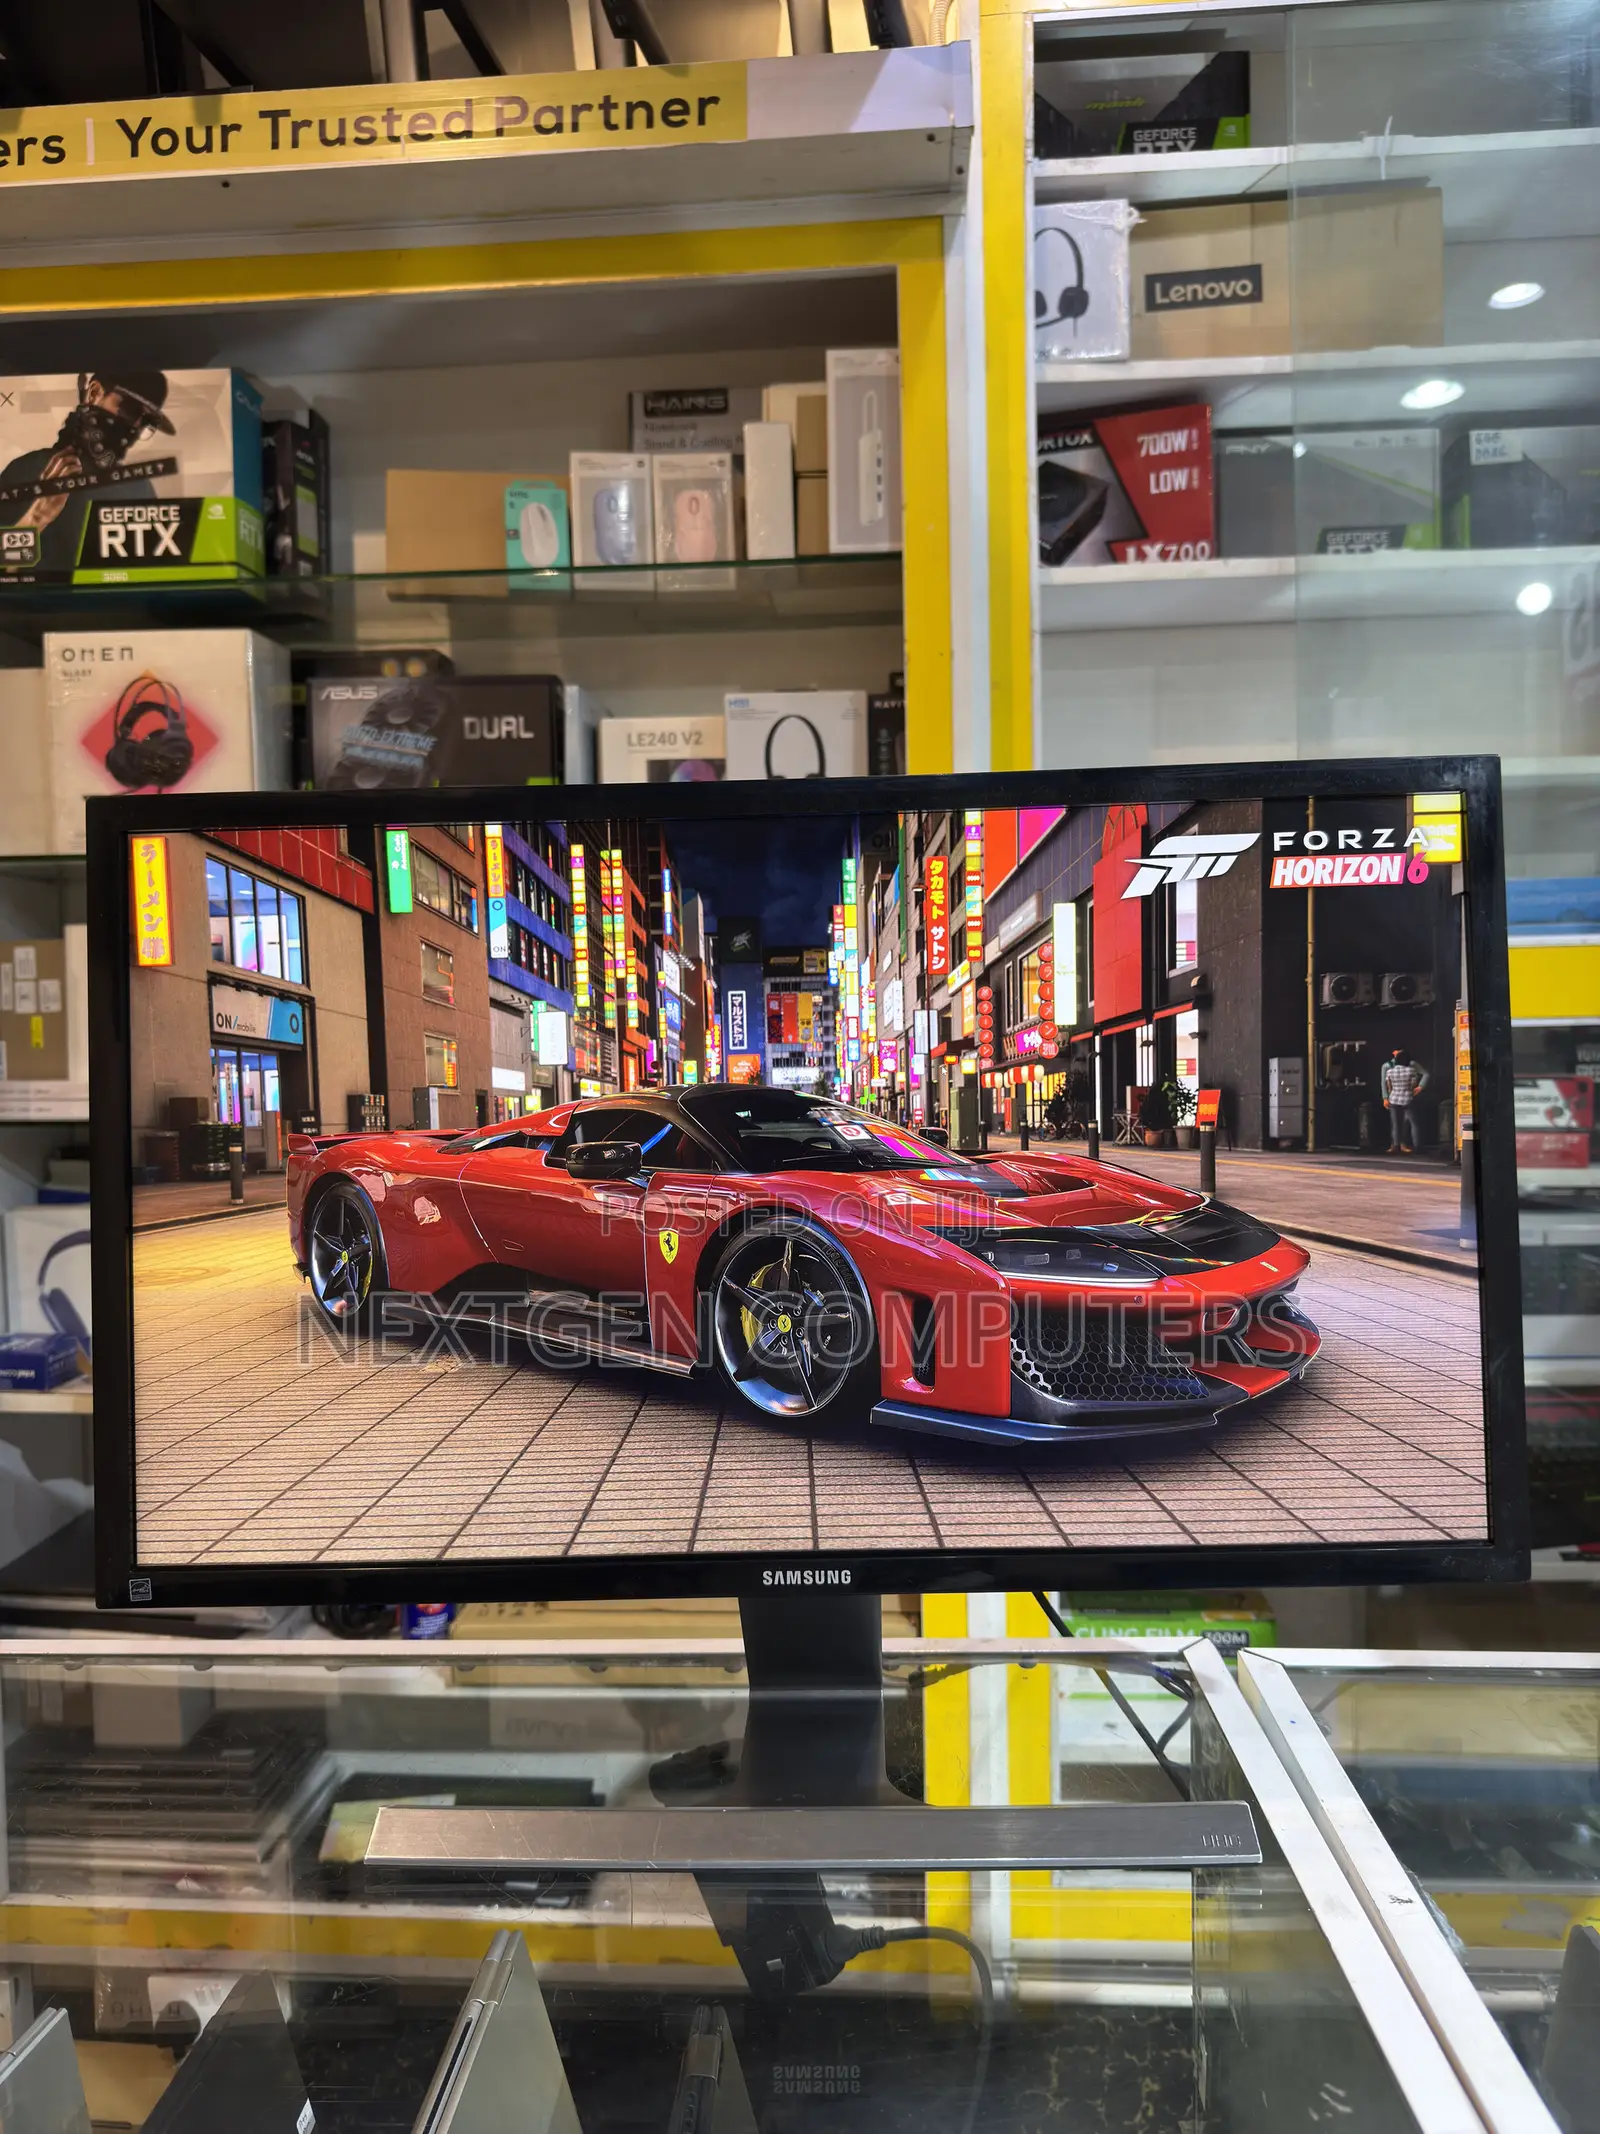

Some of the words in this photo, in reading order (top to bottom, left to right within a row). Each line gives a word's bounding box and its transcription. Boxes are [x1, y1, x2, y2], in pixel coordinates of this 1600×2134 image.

[116, 117, 242, 158] Your
[258, 98, 473, 150] Trusted
[494, 93, 721, 137] Partner
[1133, 127, 1197, 141] GEFORCE
[1154, 279, 1253, 305] Lenovo
[1149, 468, 1190, 495] LOW
[100, 505, 180, 523] GEFORCE
[100, 523, 182, 558] RTX
[1326, 532, 1390, 545] GEFORCE
[62, 647, 133, 662] OMEN
[321, 686, 378, 700] ASUS
[463, 715, 535, 740] DUAL
[627, 732, 678, 747] LE240
[682, 730, 704, 745] V2
[1273, 827, 1429, 852] FORZA
[1273, 855, 1402, 886] HORIZON
[1407, 852, 1430, 885] 6
[930, 860, 945, 920] タカモト
[931, 926, 946, 970] サトシ
[762, 1569, 851, 1585] SAMSUNG
